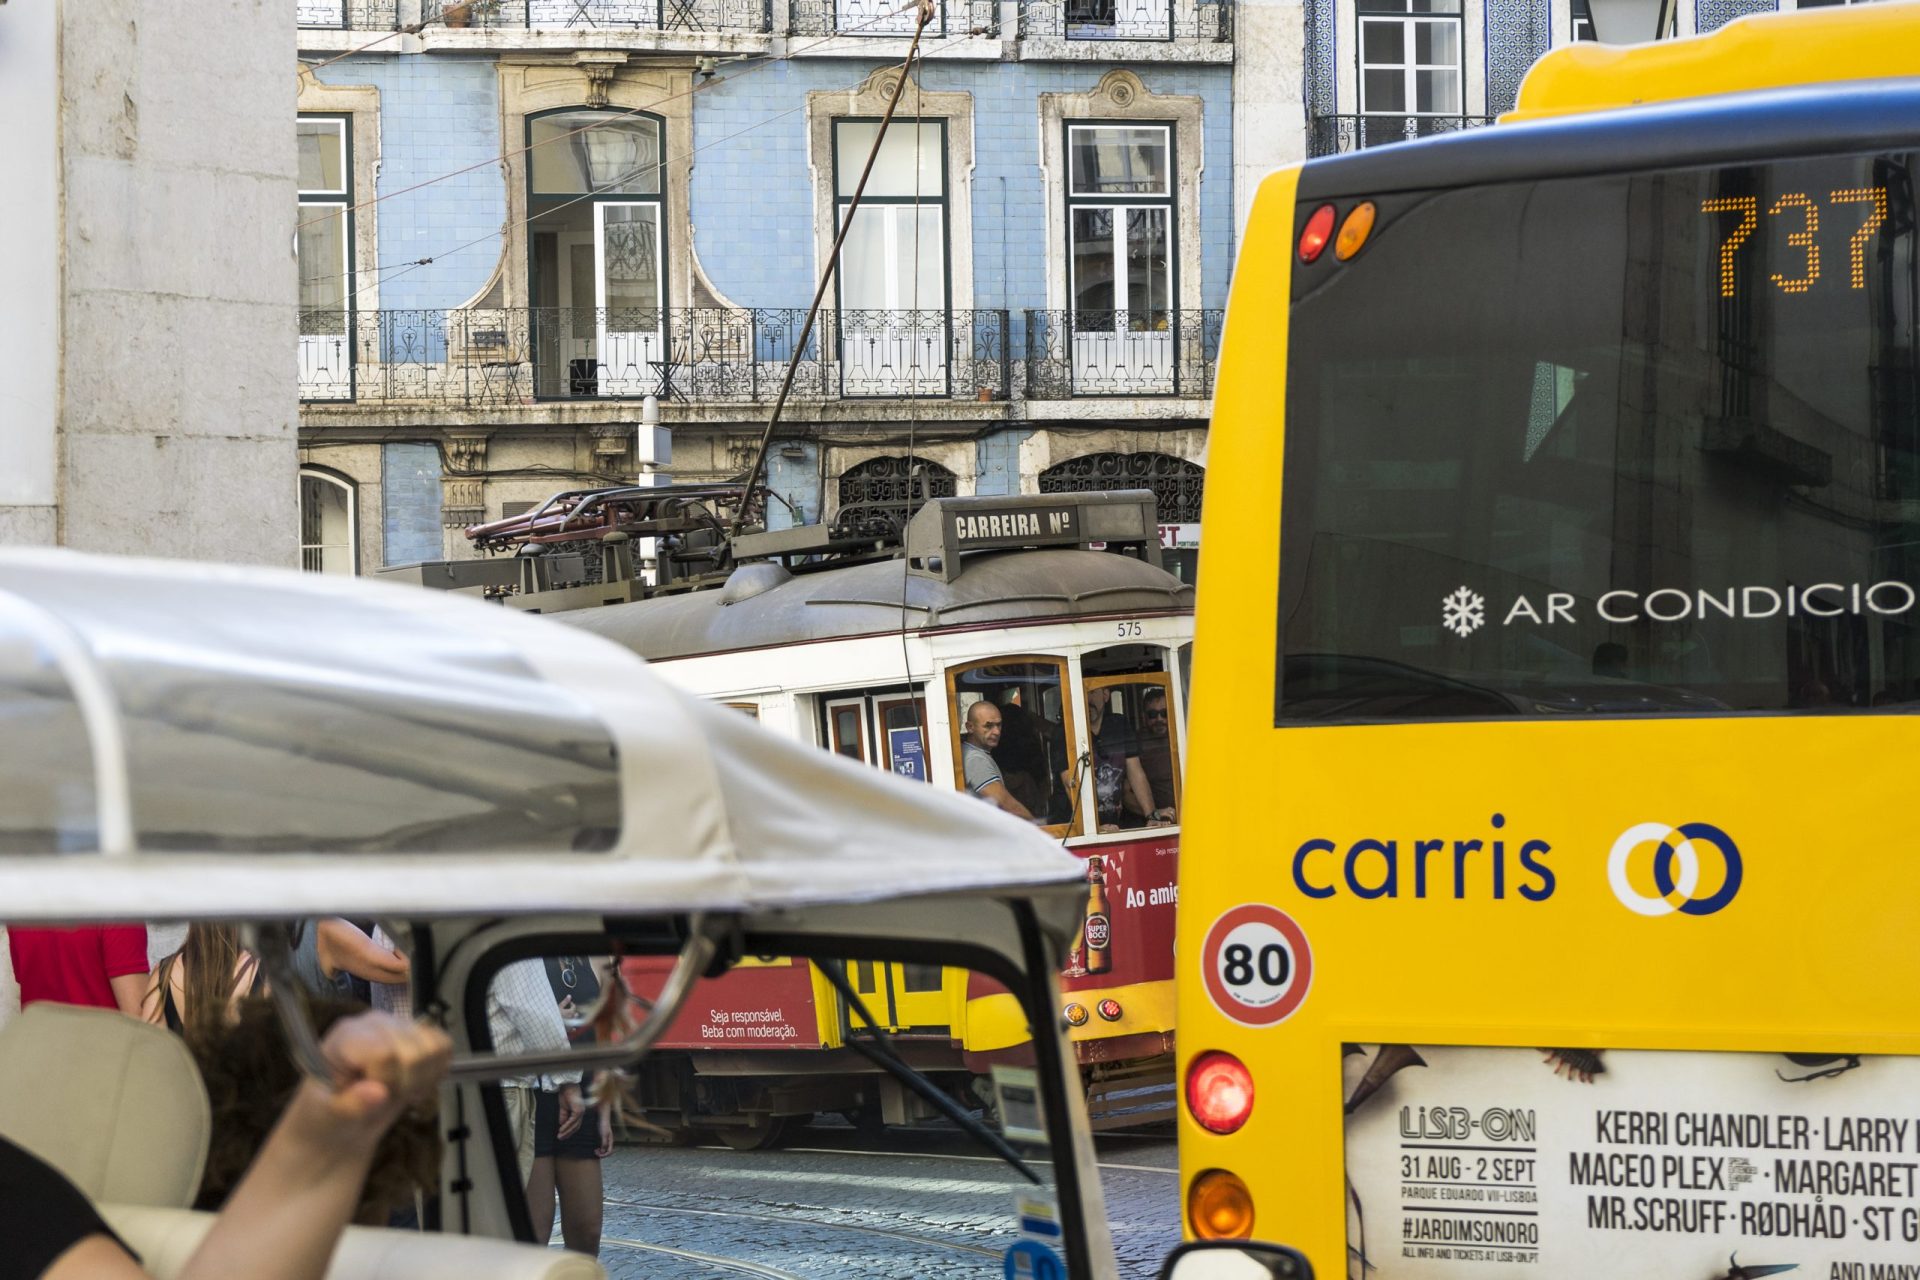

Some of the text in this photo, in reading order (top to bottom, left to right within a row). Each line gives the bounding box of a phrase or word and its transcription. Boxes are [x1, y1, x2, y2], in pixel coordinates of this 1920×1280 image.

[1701, 186, 1887, 297] 737
[956, 513, 1041, 539] CARREIRA
[1503, 581, 1916, 625] AR CONDICIO
[1117, 622, 1142, 637] 575
[1292, 813, 1556, 902] carris
[1126, 888, 1146, 908] Ao
[1223, 943, 1290, 986] 80
[711, 1008, 784, 1025] Seja responsável.
[702, 1024, 798, 1040] Beba com moderação.
[1597, 1110, 1668, 1145] KERRI
[1675, 1112, 1810, 1150] CHANDLER
[1824, 1116, 1908, 1153] LARRY
[1401, 1155, 1420, 1178] 31
[1427, 1156, 1461, 1179] AUG
[1477, 1158, 1487, 1180] 2
[1493, 1158, 1535, 1182] SEPT
[1569, 1152, 1918, 1197] MACEO PLEX MARGARET
[1402, 1186, 1437, 1200] PARQUE
[1440, 1188, 1484, 1201] EDUARDO
[1403, 1217, 1539, 1244] #JARDIMSONORO
[1588, 1195, 1727, 1233] MR.SCRUFF
[1741, 1195, 1846, 1239] RØDHÅD
[1863, 1206, 1894, 1241] ST
[1402, 1246, 1416, 1258] ALL
[1418, 1248, 1434, 1259] INFO
[1436, 1248, 1451, 1260] AND
[1453, 1249, 1484, 1261] TICKETS
[1486, 1251, 1495, 1261] AT
[1831, 1262, 1920, 1280] AND MANY
